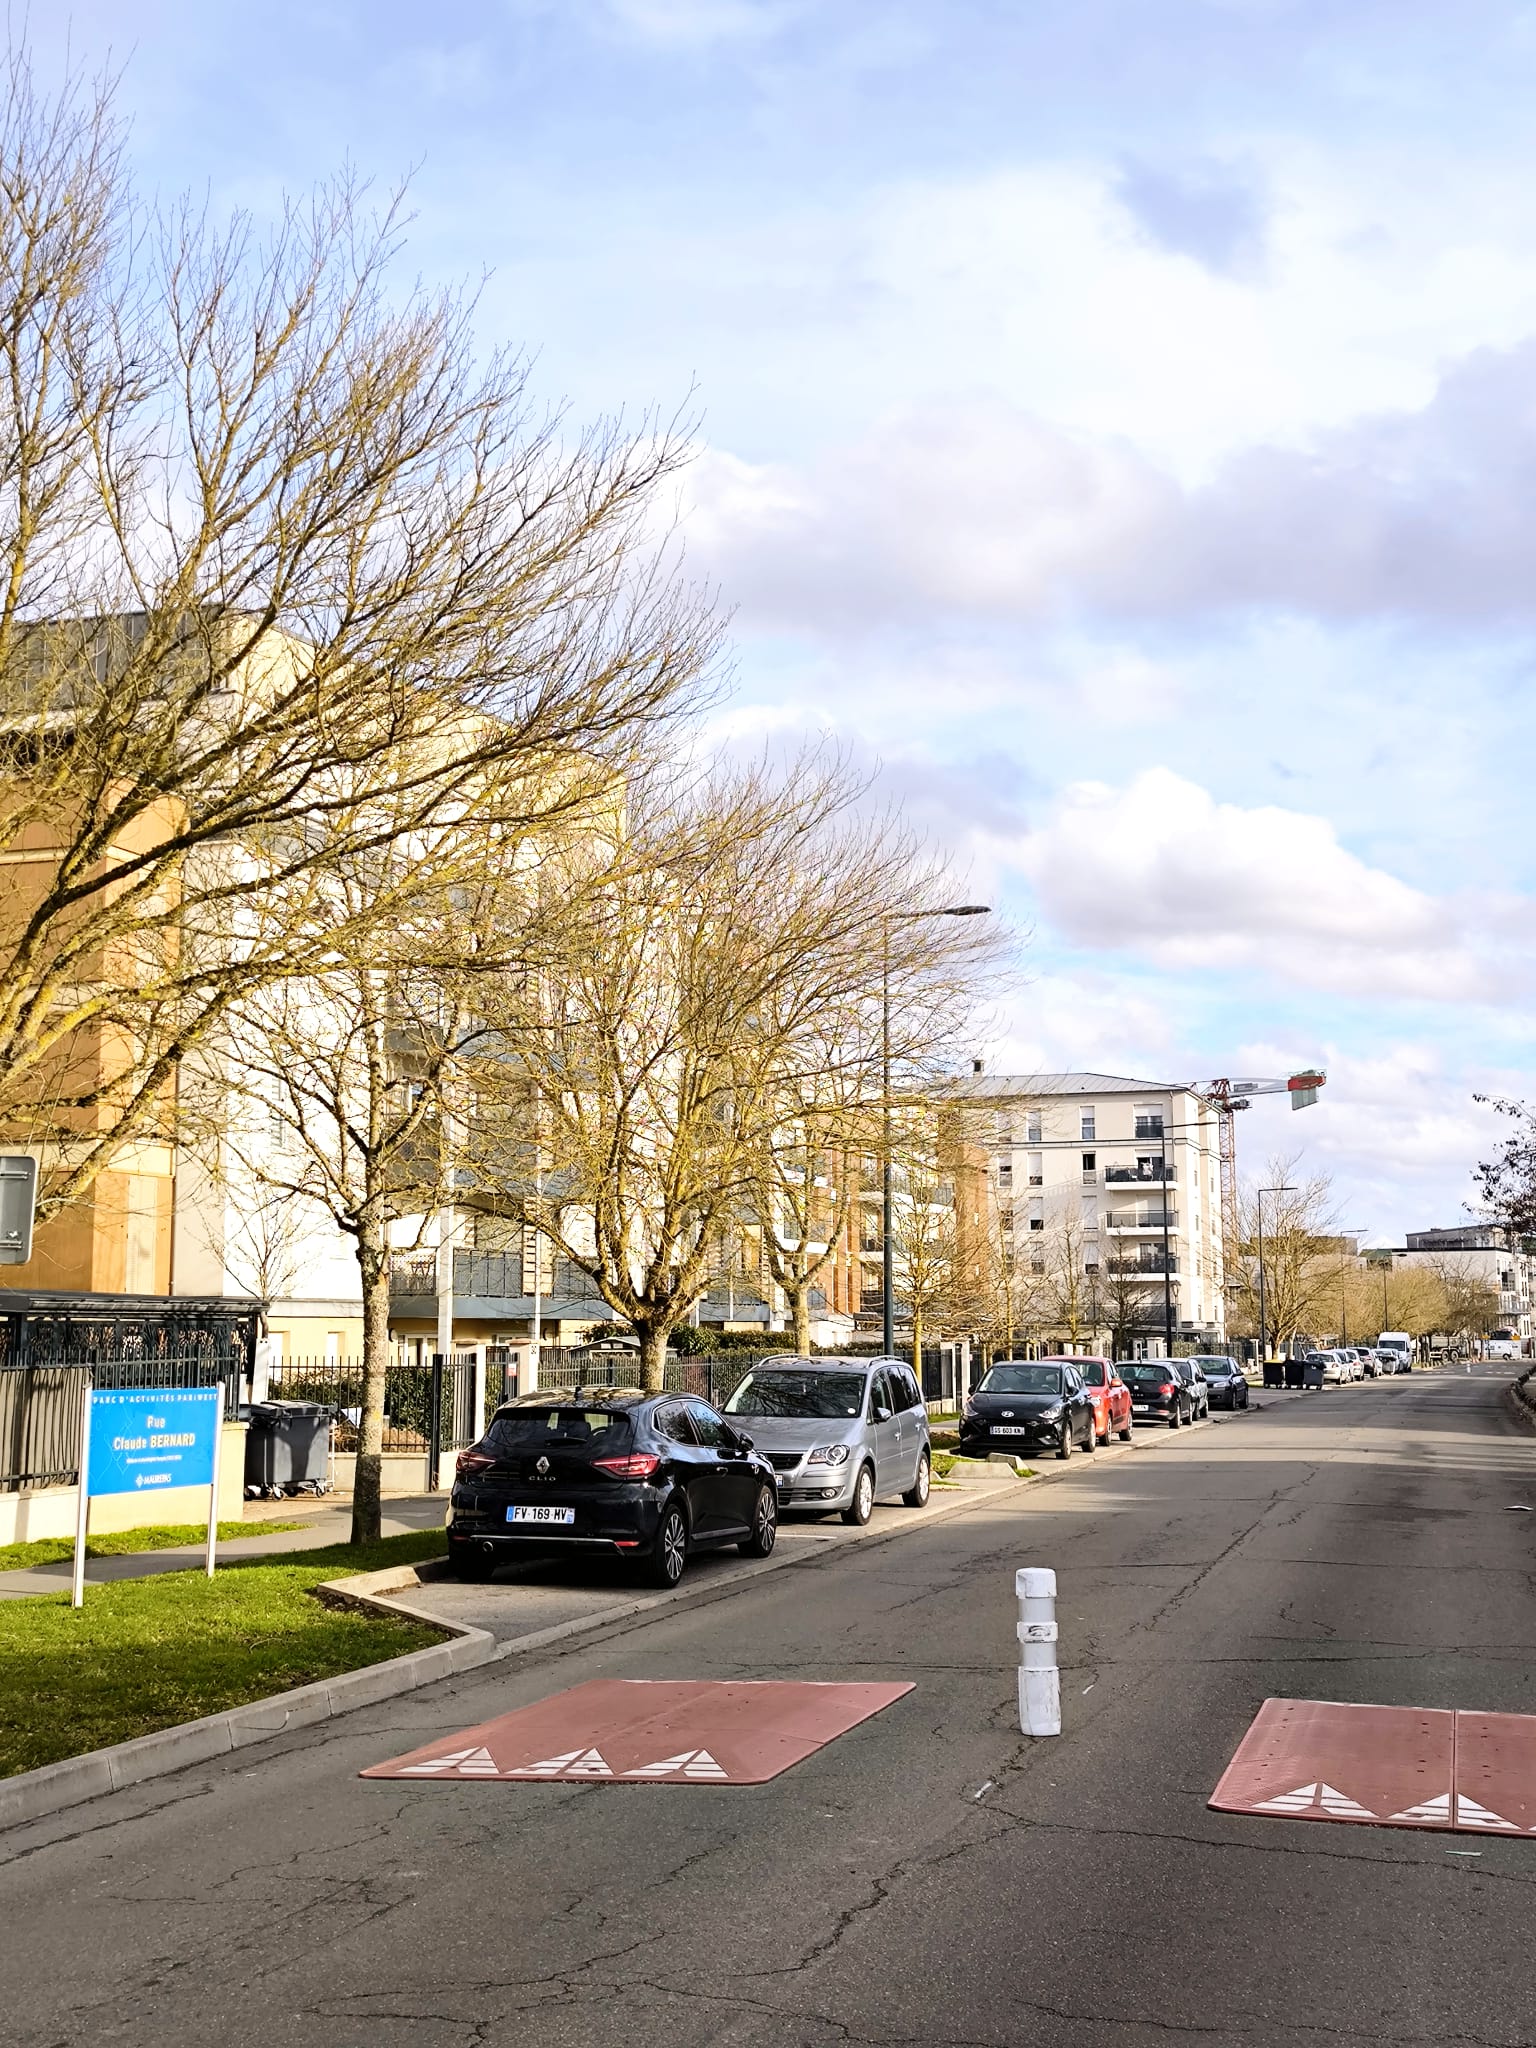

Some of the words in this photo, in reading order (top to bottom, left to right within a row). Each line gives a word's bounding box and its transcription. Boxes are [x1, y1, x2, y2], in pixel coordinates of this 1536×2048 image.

[93, 1396, 116, 1404] PARC
[119, 1394, 175, 1404] D'ACTIVITÉS
[147, 1415, 165, 1428] Rue
[113, 1436, 147, 1450] Claude
[150, 1433, 195, 1447] BERNARD
